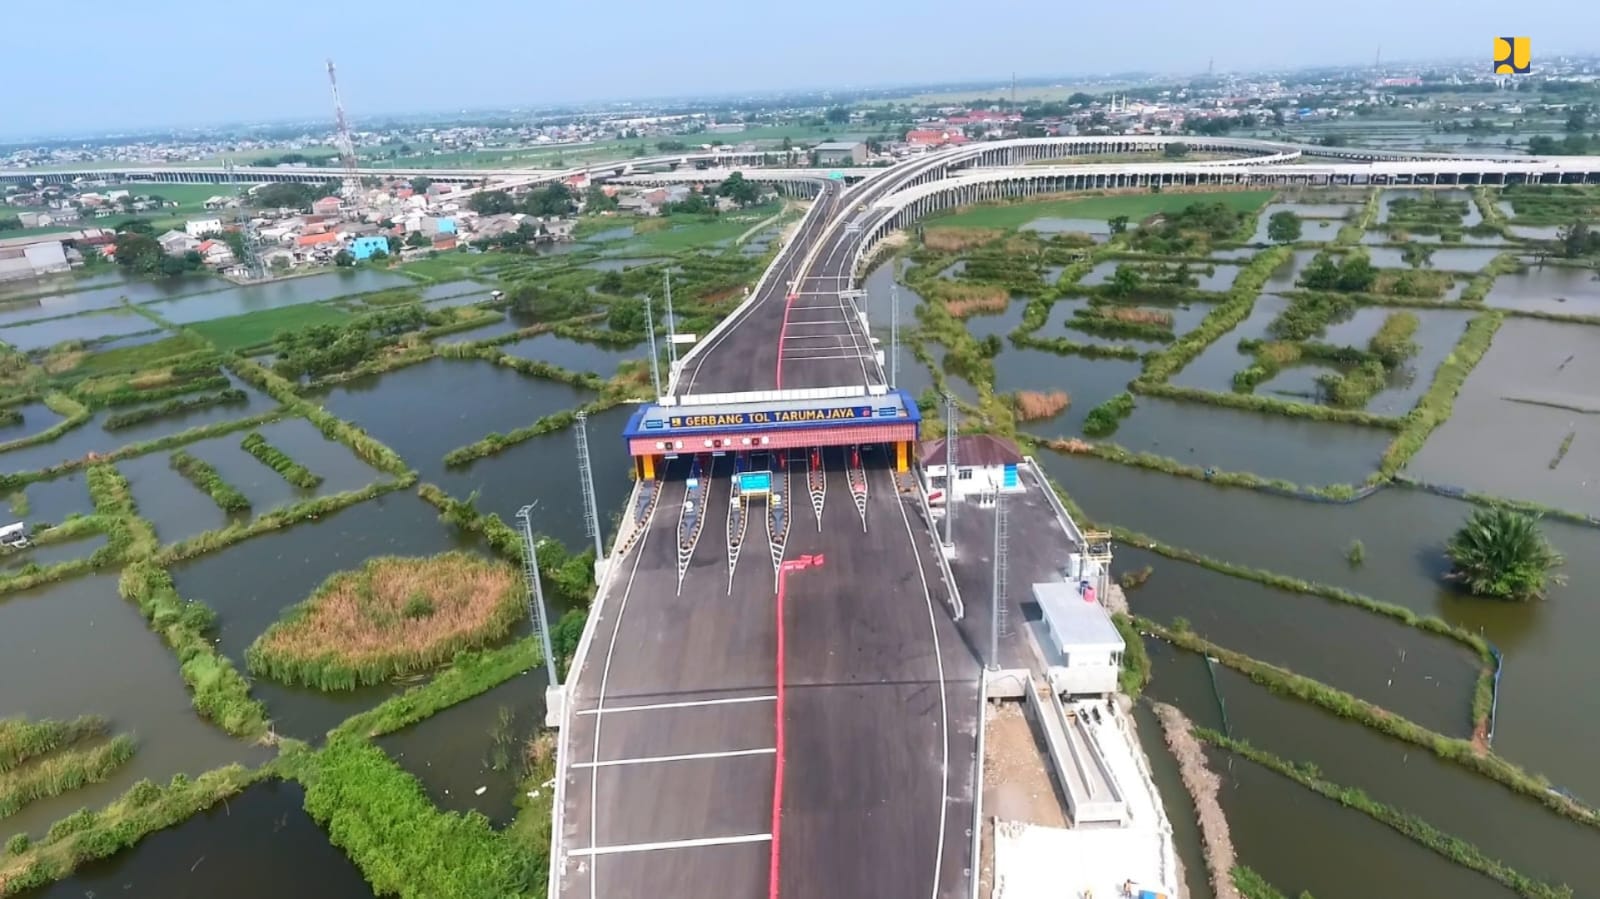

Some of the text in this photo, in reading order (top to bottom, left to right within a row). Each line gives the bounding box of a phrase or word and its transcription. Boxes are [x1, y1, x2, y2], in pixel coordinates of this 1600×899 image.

[685, 408, 855, 426] GERBANG TOL TARUMAJAYA
